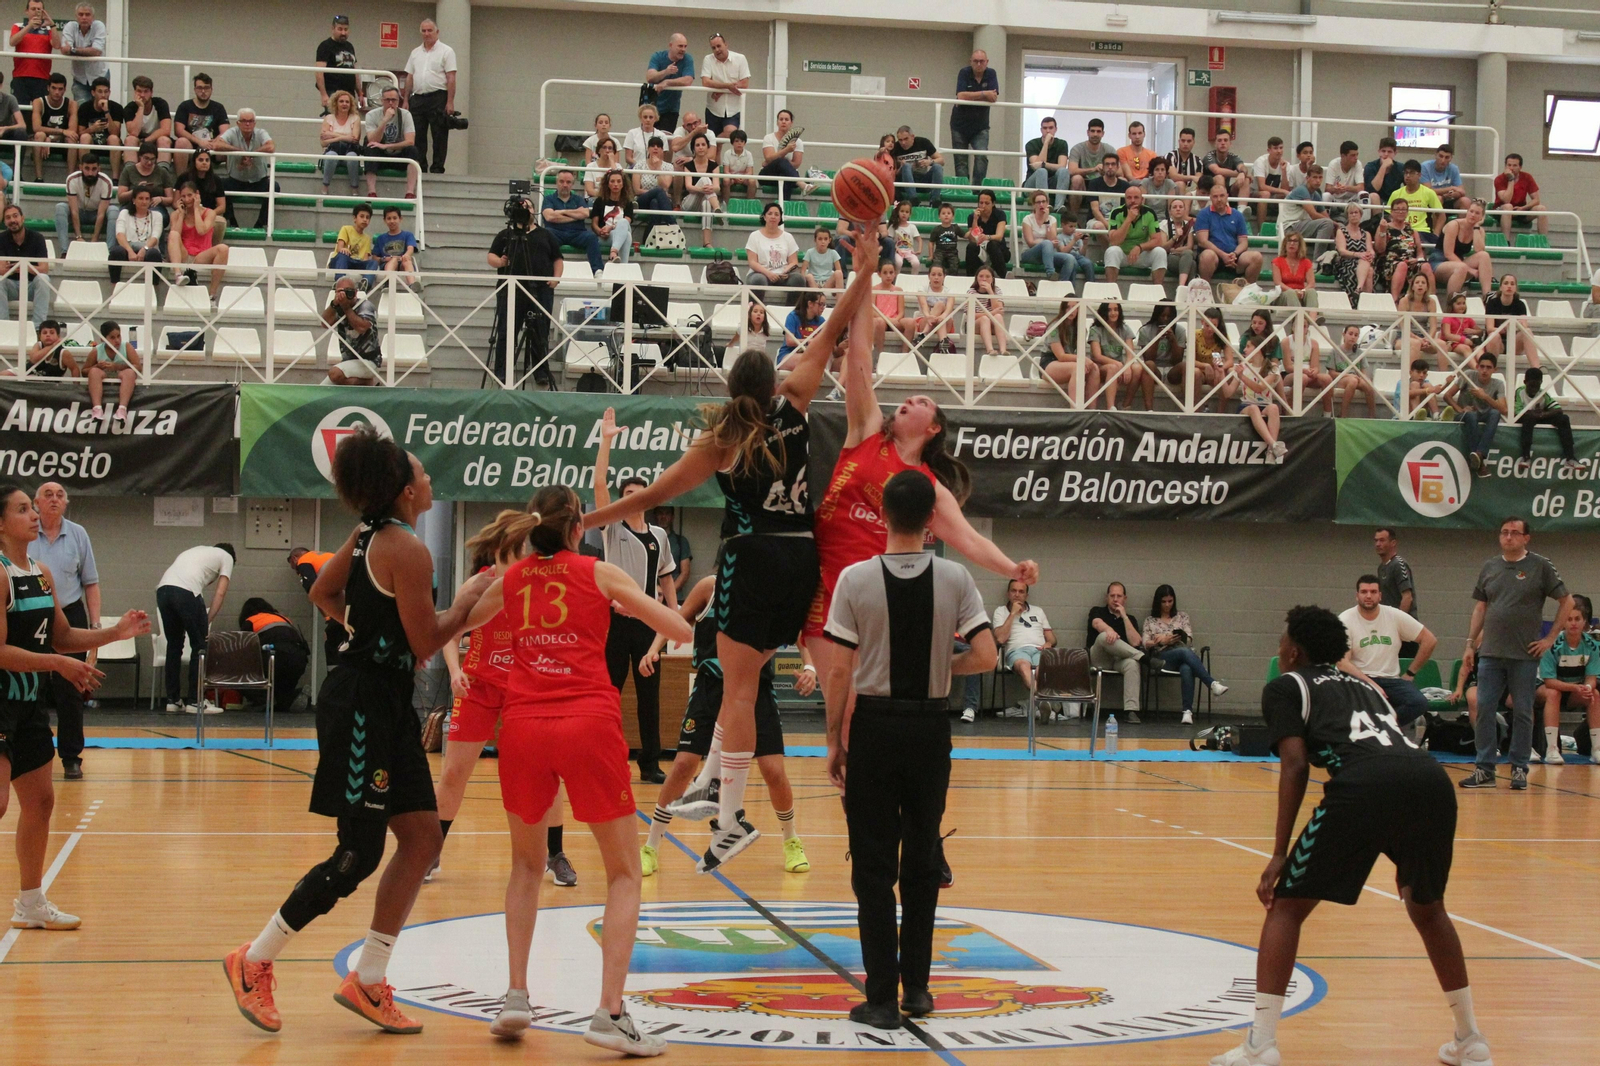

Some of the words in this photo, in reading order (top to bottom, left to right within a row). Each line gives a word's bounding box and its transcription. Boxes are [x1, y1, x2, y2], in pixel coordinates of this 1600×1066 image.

[1098, 42, 1122, 51] Salida
[810, 62, 827, 70] Servicios
[832, 63, 846, 71] Señoras
[1, 399, 178, 435] Andaluza
[404, 413, 577, 448] Federación
[953, 426, 1125, 462] Federación
[463, 456, 502, 487] de
[1012, 470, 1050, 502] de
[1059, 470, 1229, 506] Baloncesto
[1531, 488, 1565, 518] de
[521, 563, 570, 578] RAQUEL
[515, 581, 568, 631] 13
[33, 617, 49, 646] 4
[1360, 634, 1393, 649] CAB
[777, 663, 802, 671] guamar
